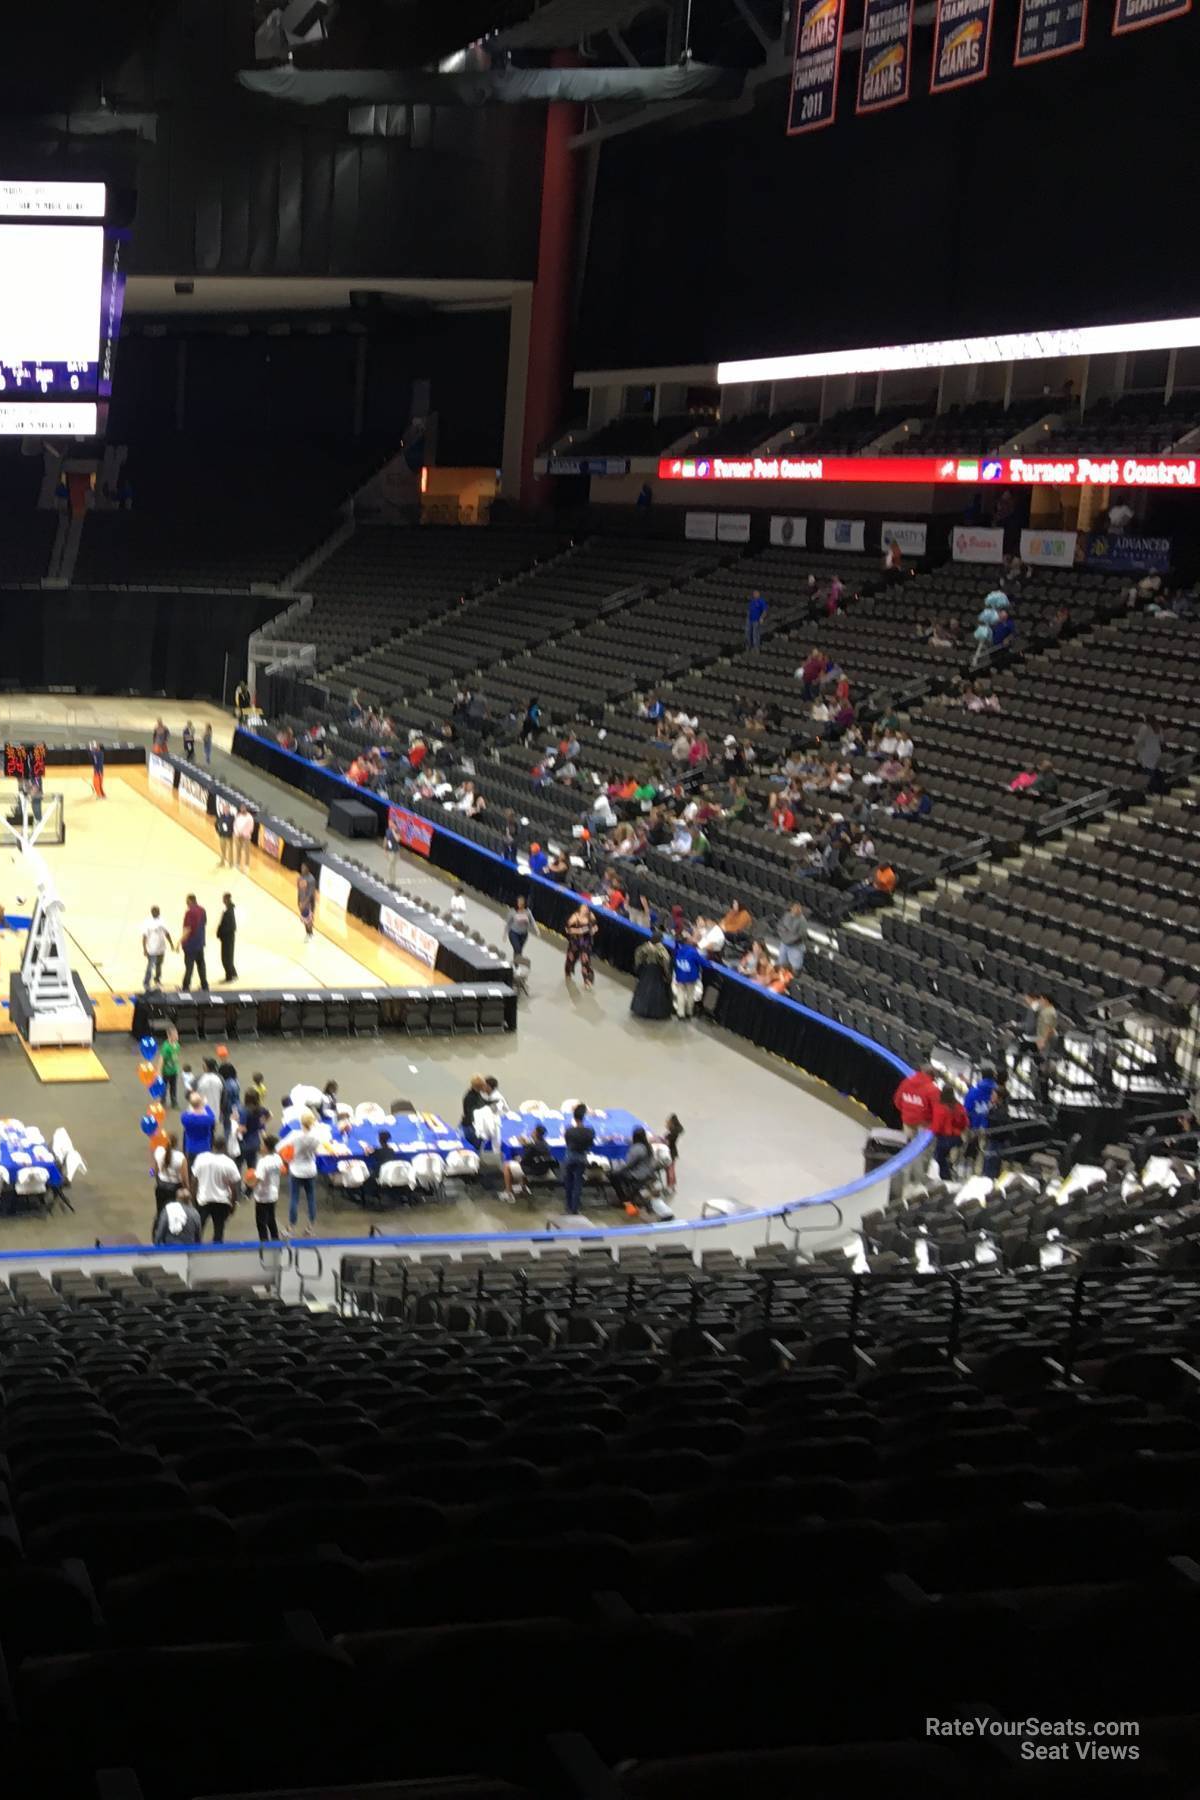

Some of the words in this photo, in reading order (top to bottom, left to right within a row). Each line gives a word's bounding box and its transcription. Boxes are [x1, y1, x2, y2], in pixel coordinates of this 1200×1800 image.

[939, 38, 980, 78] GIANTS
[863, 63, 902, 101] GIANTS
[801, 91, 823, 120] 2011
[714, 459, 752, 478] Turner
[754, 459, 778, 478] Pest
[781, 460, 822, 479] Control
[1009, 459, 1074, 482] Turner
[1077, 459, 1118, 482] Pest
[1123, 460, 1195, 484] Control
[1115, 537, 1170, 553] ADVANCED
